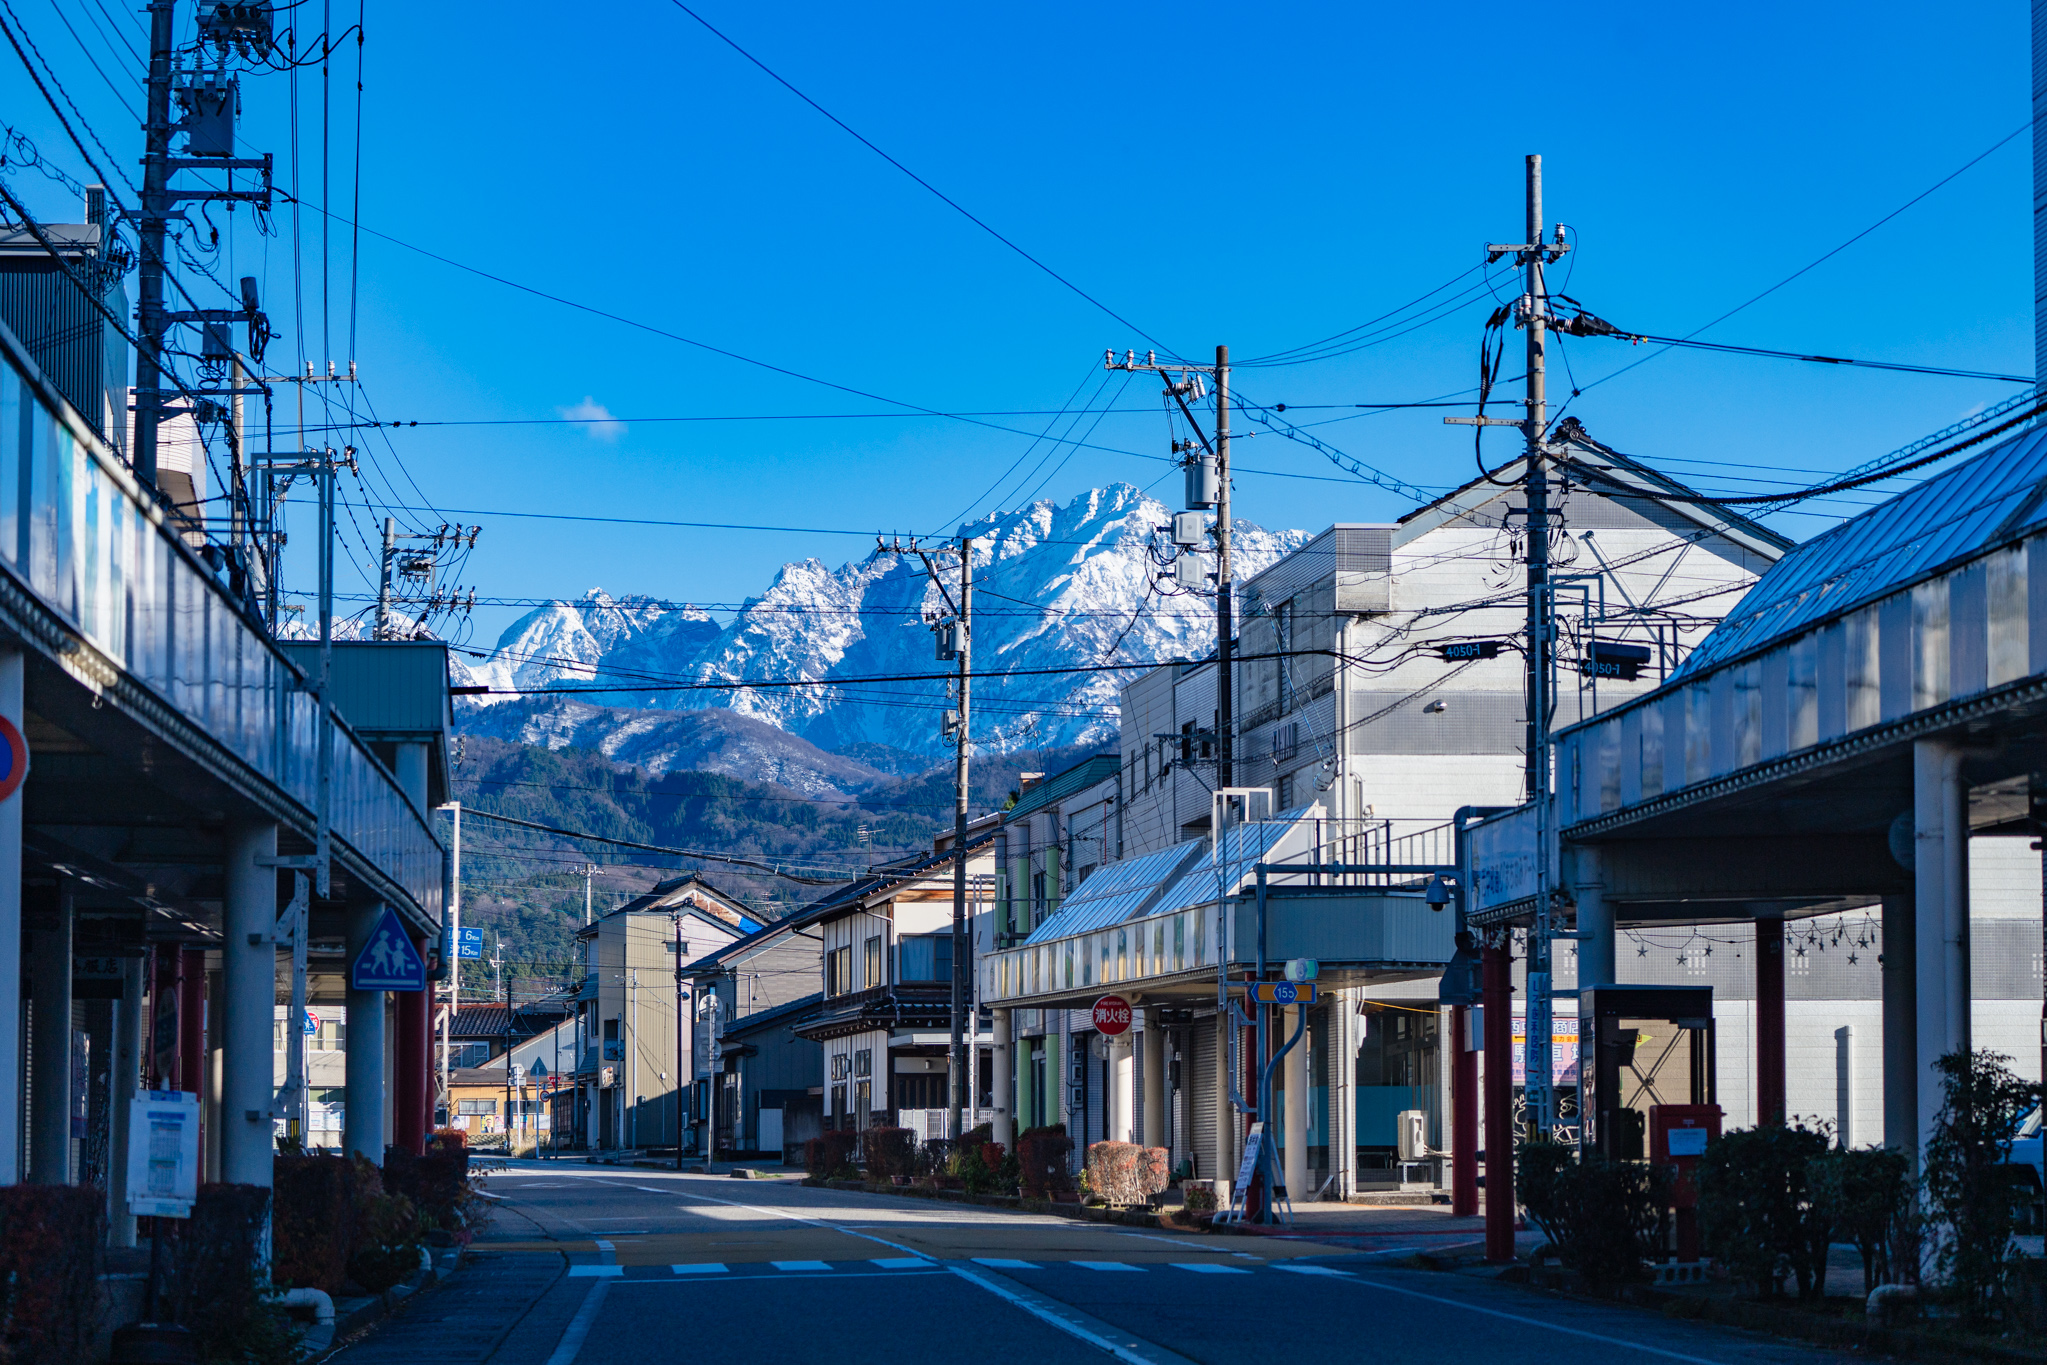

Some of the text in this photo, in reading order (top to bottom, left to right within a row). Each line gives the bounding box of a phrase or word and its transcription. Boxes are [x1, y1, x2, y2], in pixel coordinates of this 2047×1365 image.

[1446, 644, 1481, 658] 4050-1
[1095, 1008, 1130, 1024] 消火栓
